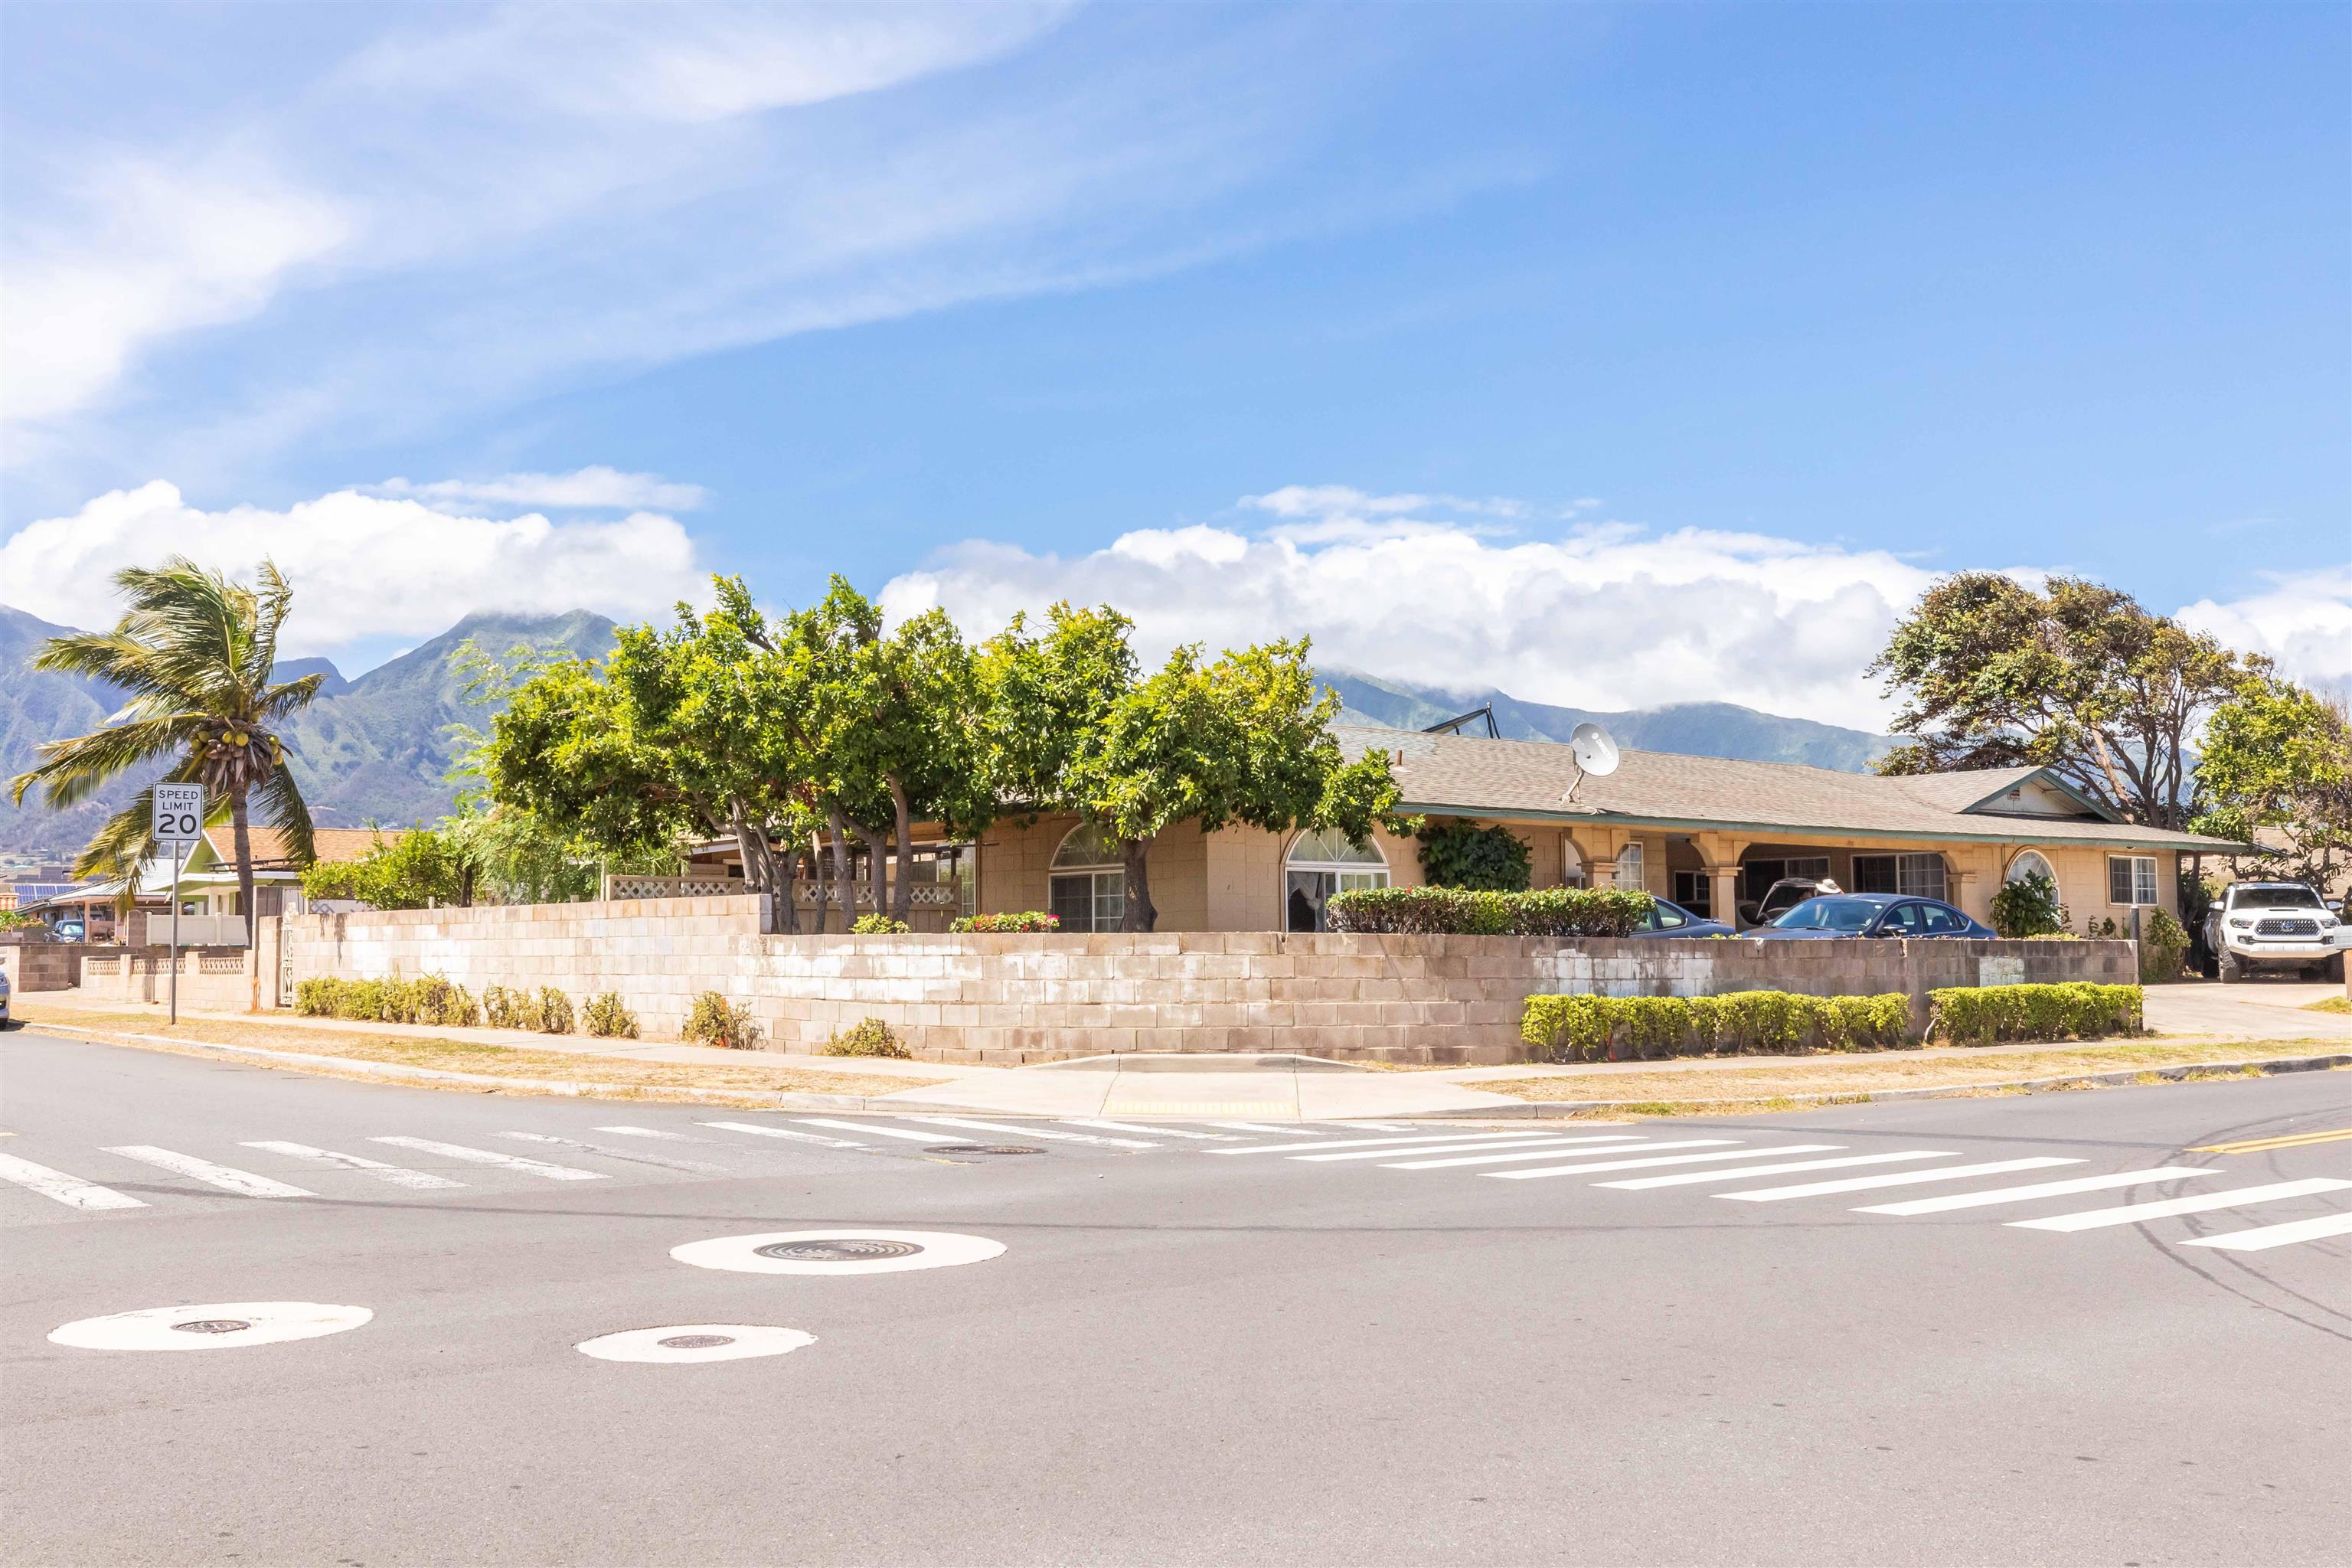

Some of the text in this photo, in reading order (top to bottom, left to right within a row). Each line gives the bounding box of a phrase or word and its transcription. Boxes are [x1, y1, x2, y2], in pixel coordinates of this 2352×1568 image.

[158, 789, 198, 799] SPEED
[162, 802, 194, 811] LIMIT
[158, 813, 197, 835] 20
